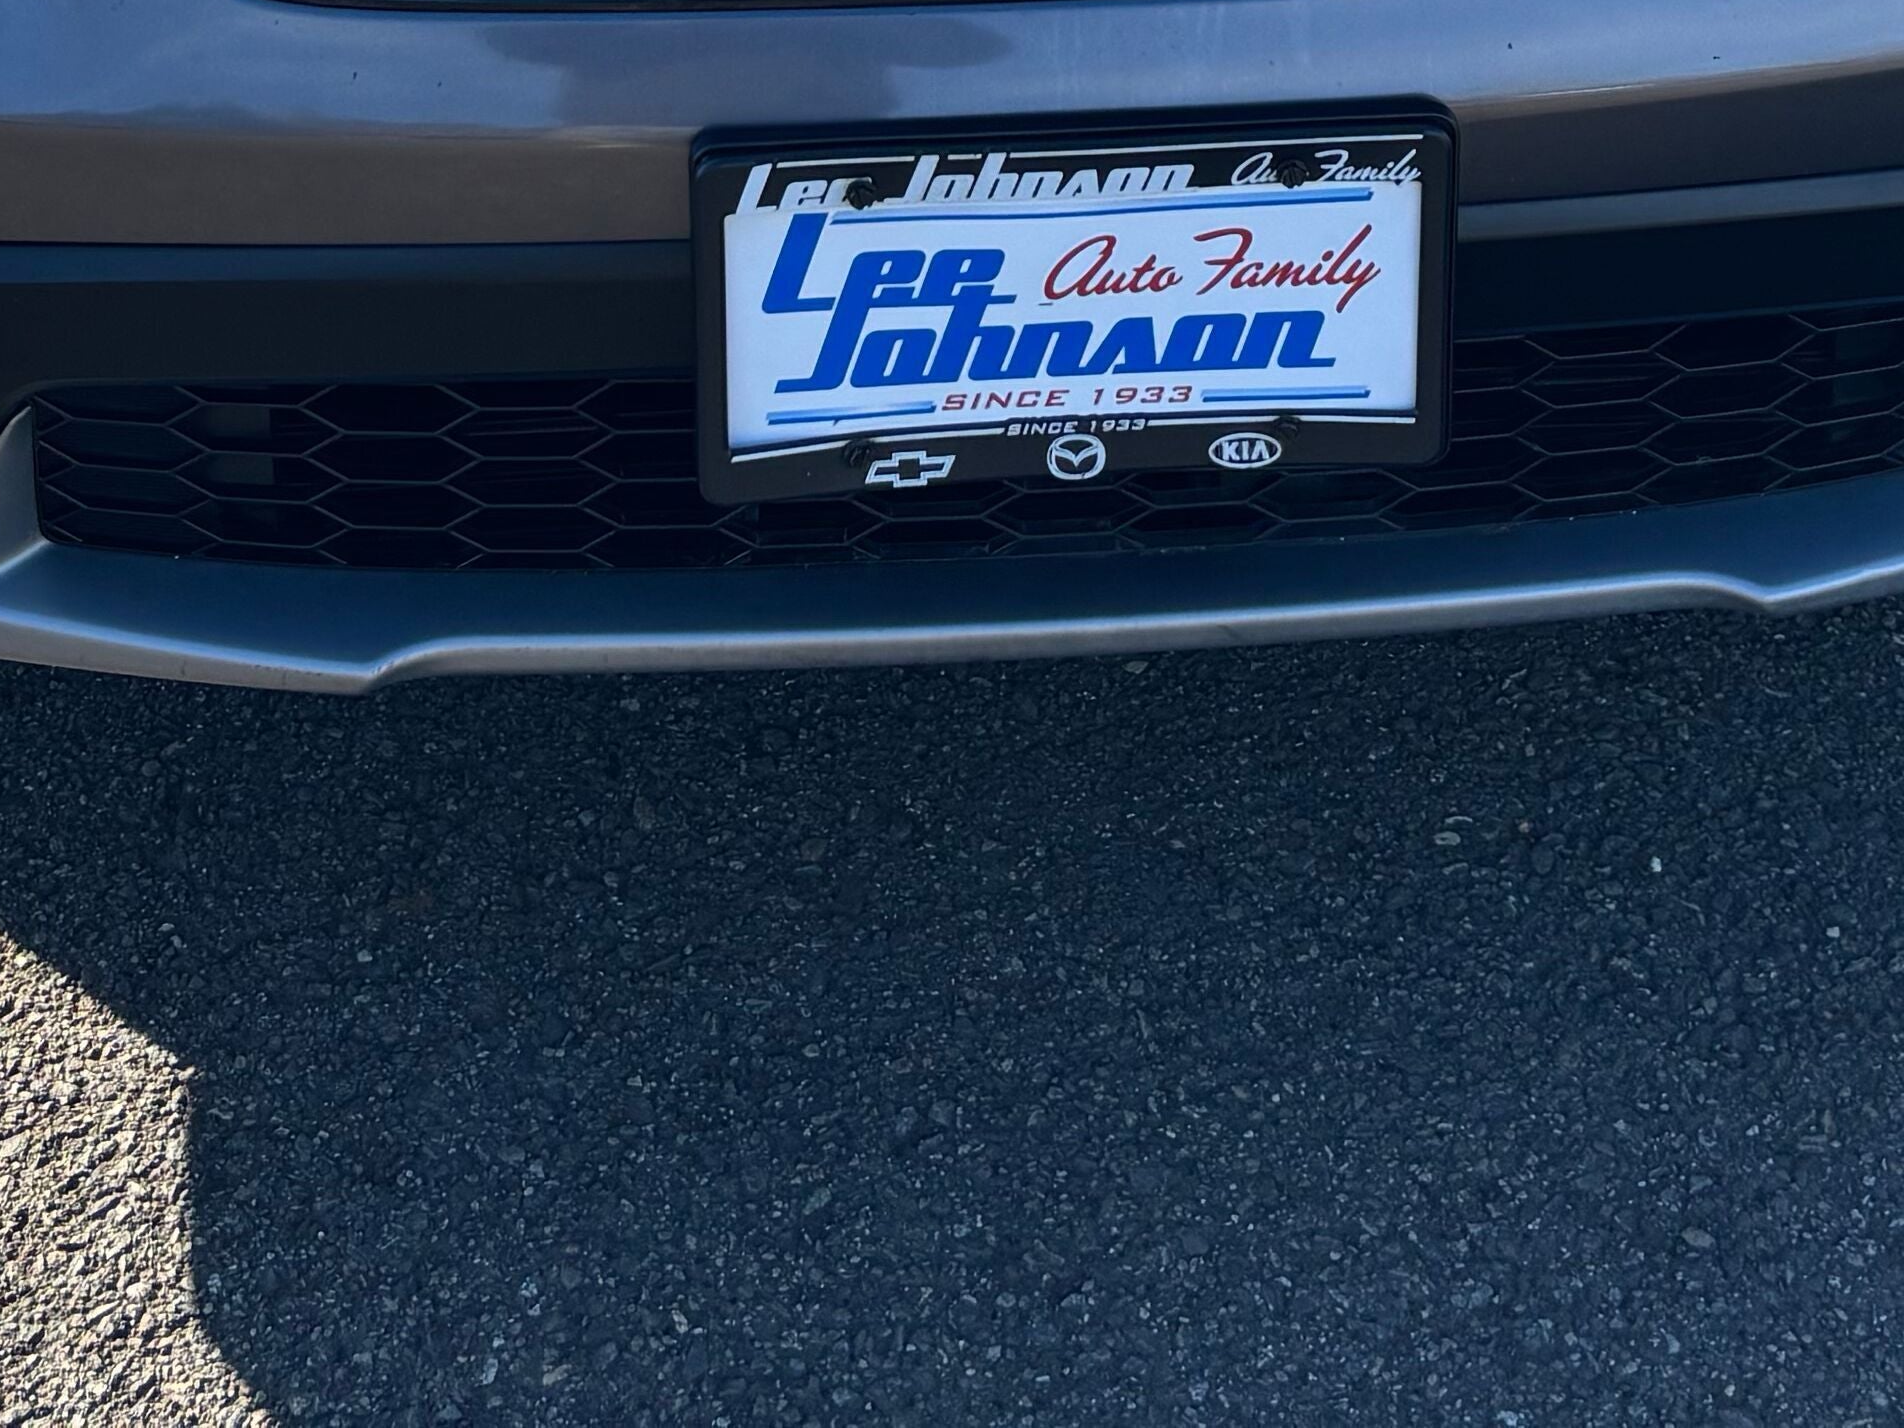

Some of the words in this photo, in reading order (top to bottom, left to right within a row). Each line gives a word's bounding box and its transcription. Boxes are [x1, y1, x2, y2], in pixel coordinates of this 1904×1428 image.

[884, 152, 1195, 203] Johnson
[1314, 148, 1421, 185] Family
[762, 212, 1016, 314] Lee
[1044, 235, 1183, 300] Auto
[1193, 224, 1381, 313] Family
[775, 299, 1336, 394] Johnson
[941, 389, 1070, 412] SINCE
[1093, 386, 1193, 405] 1933
[1007, 421, 1078, 436] SINCE
[1090, 418, 1146, 433] 1933
[1222, 439, 1270, 462] KIA
